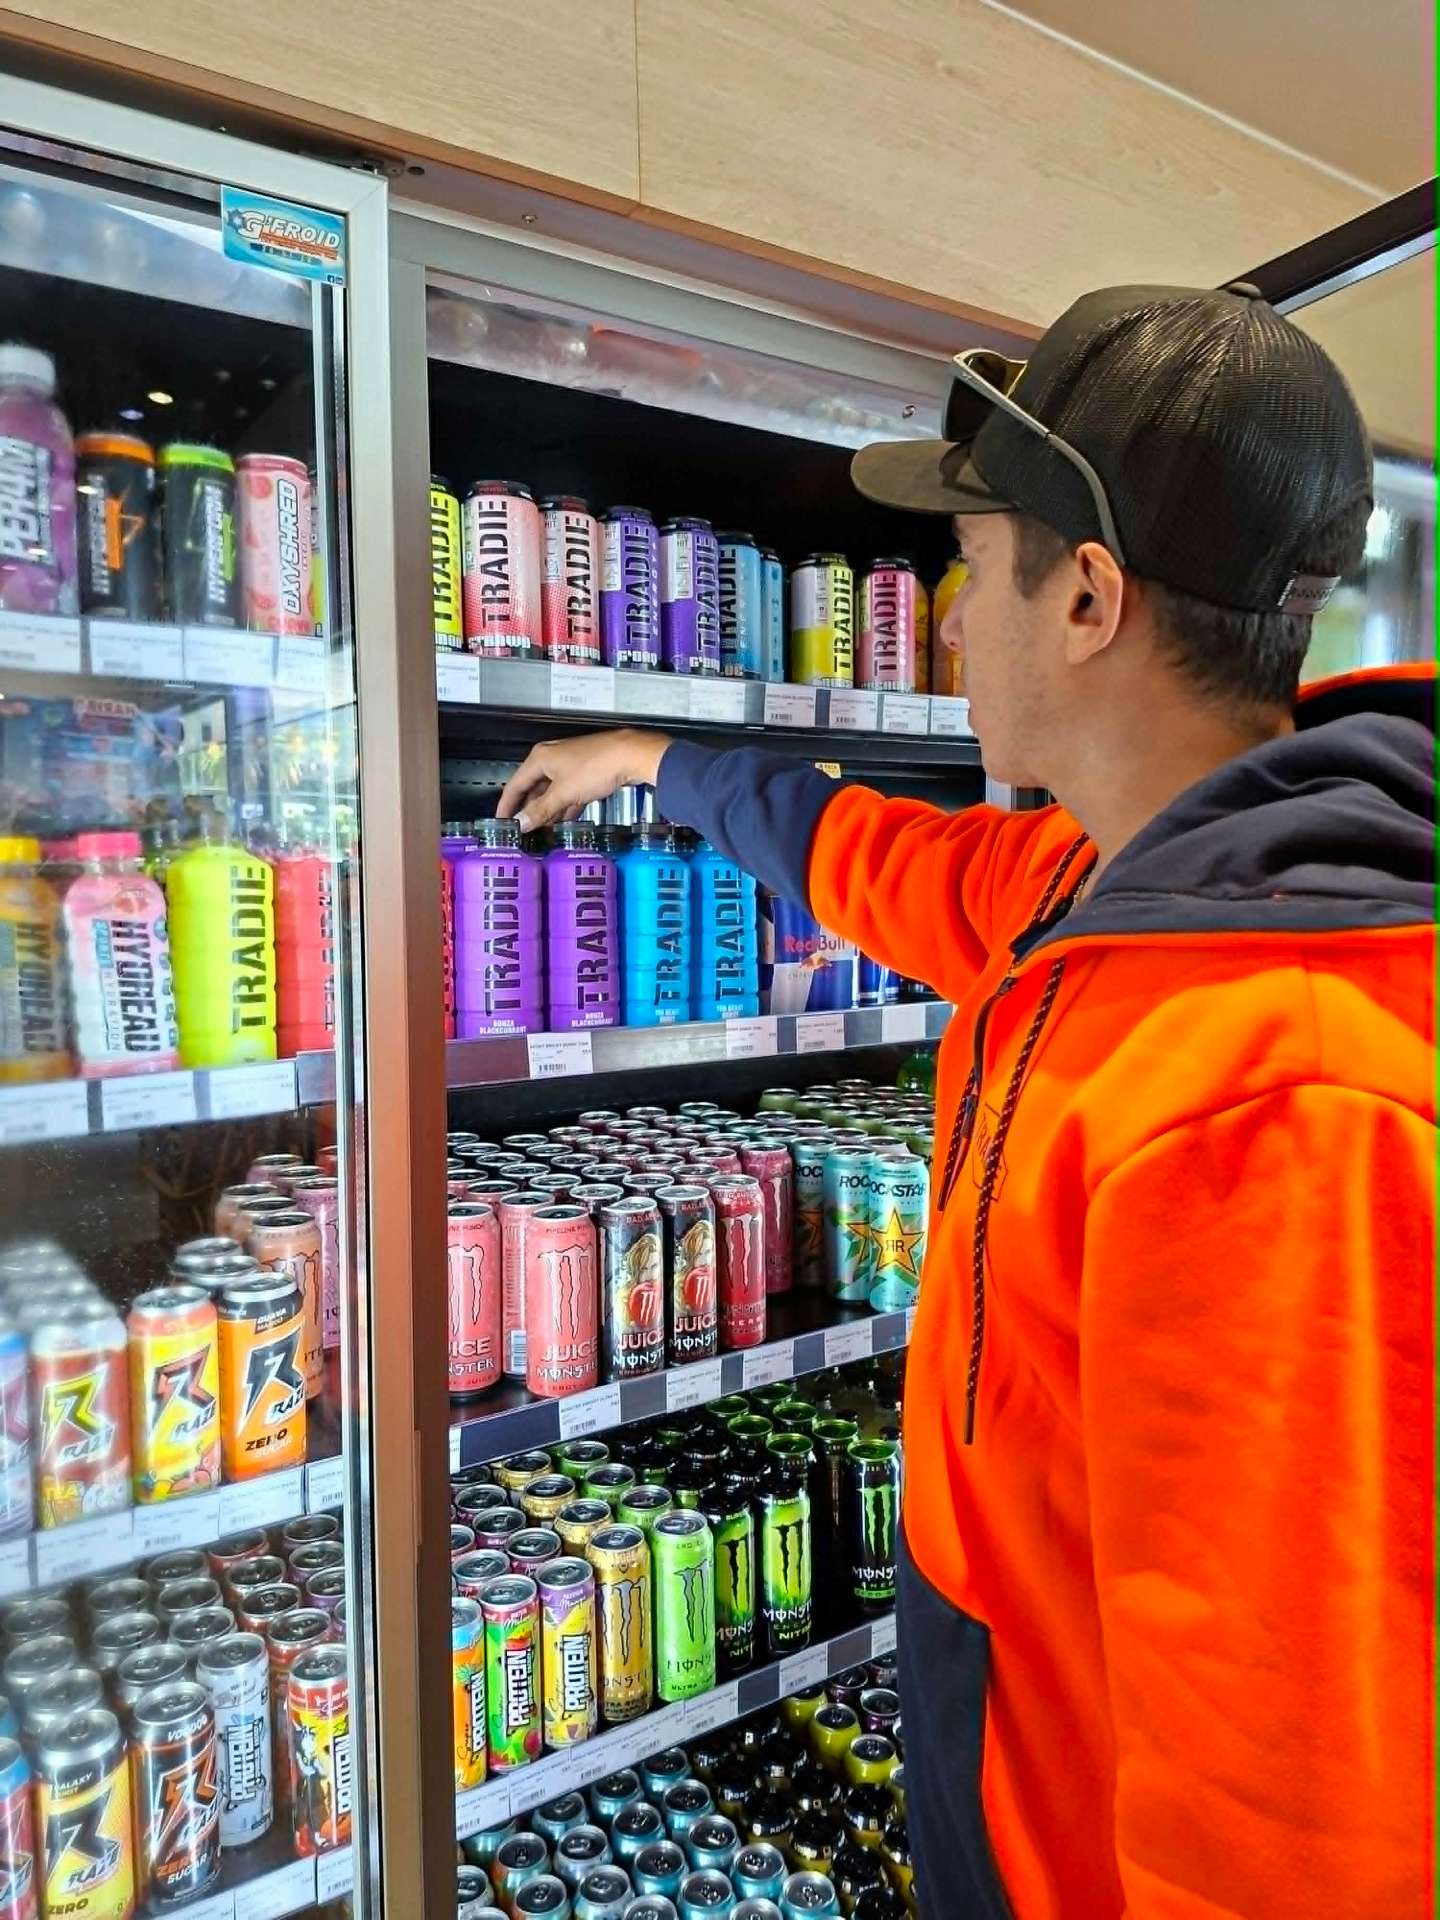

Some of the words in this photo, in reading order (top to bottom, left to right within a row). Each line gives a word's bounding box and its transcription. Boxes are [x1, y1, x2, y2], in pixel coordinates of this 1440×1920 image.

[479, 501, 510, 629] TRADIE
[565, 515, 592, 638] TRADIE
[625, 525, 650, 645] TRADIE
[696, 535, 718, 651] TRADIE
[834, 569, 851, 673] TRADIE
[874, 574, 897, 677] TRADIE
[230, 866, 266, 1034] TRADIE
[484, 866, 521, 1016] TRADIE
[575, 865, 609, 1010] TRADIE
[654, 869, 684, 1006] TRADIE
[714, 869, 745, 1001] TRADIE
[784, 935, 816, 953] Red
[819, 935, 845, 950] Bull
[111, 920, 160, 1052] HYDREAU
[870, 1181, 926, 1197] OCKSTAR
[257, 1308, 287, 1324] GUAVA
[449, 1336, 491, 1358] ICE
[669, 1330, 717, 1351] MONST
[449, 1359, 495, 1376] NSTER
[536, 1362, 598, 1383] MONST
[613, 1348, 664, 1369] MONST
[272, 1385, 305, 1416] RAZ
[763, 1599, 812, 1621] MONST
[852, 1565, 898, 1582] MONST
[716, 1621, 753, 1641] MONS
[729, 1641, 754, 1656] NIT
[507, 1650, 531, 1727] PROTEIN
[563, 1635, 587, 1711] PROTEIN
[470, 1671, 487, 1752] PROTEIN
[228, 1725, 256, 1801] PROTEIN
[48, 1898, 89, 1915] ZERO
